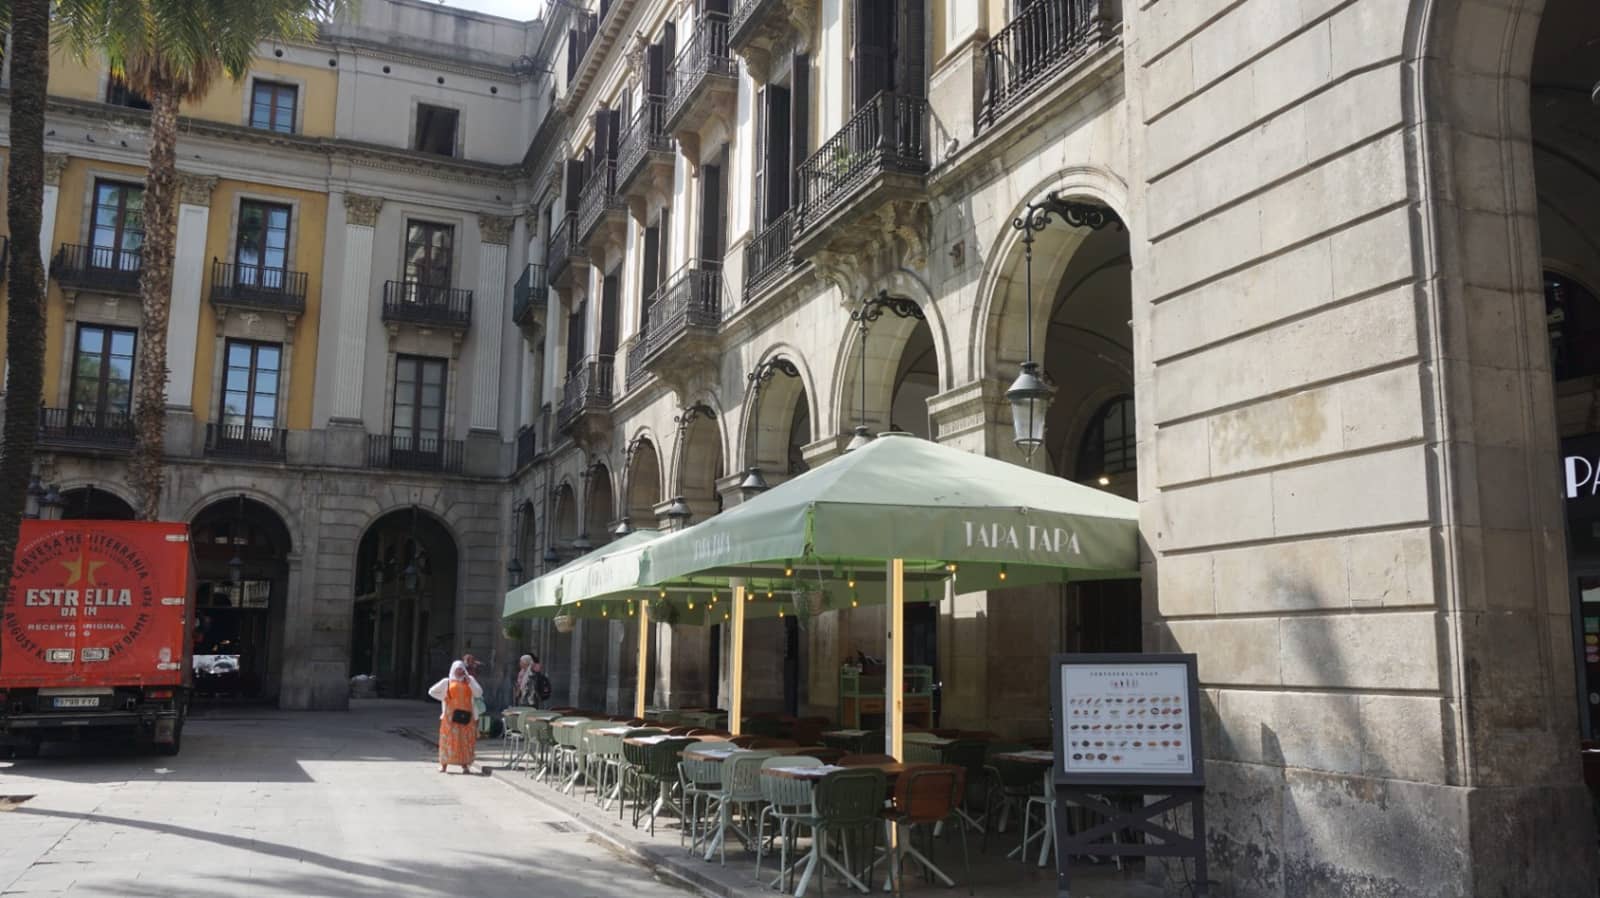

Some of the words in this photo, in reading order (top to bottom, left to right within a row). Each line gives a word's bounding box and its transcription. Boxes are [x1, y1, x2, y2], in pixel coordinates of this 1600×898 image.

[962, 521, 1019, 549] TAPA
[1026, 525, 1080, 554] TAPA
[26, 588, 132, 606] ESTRELLA
